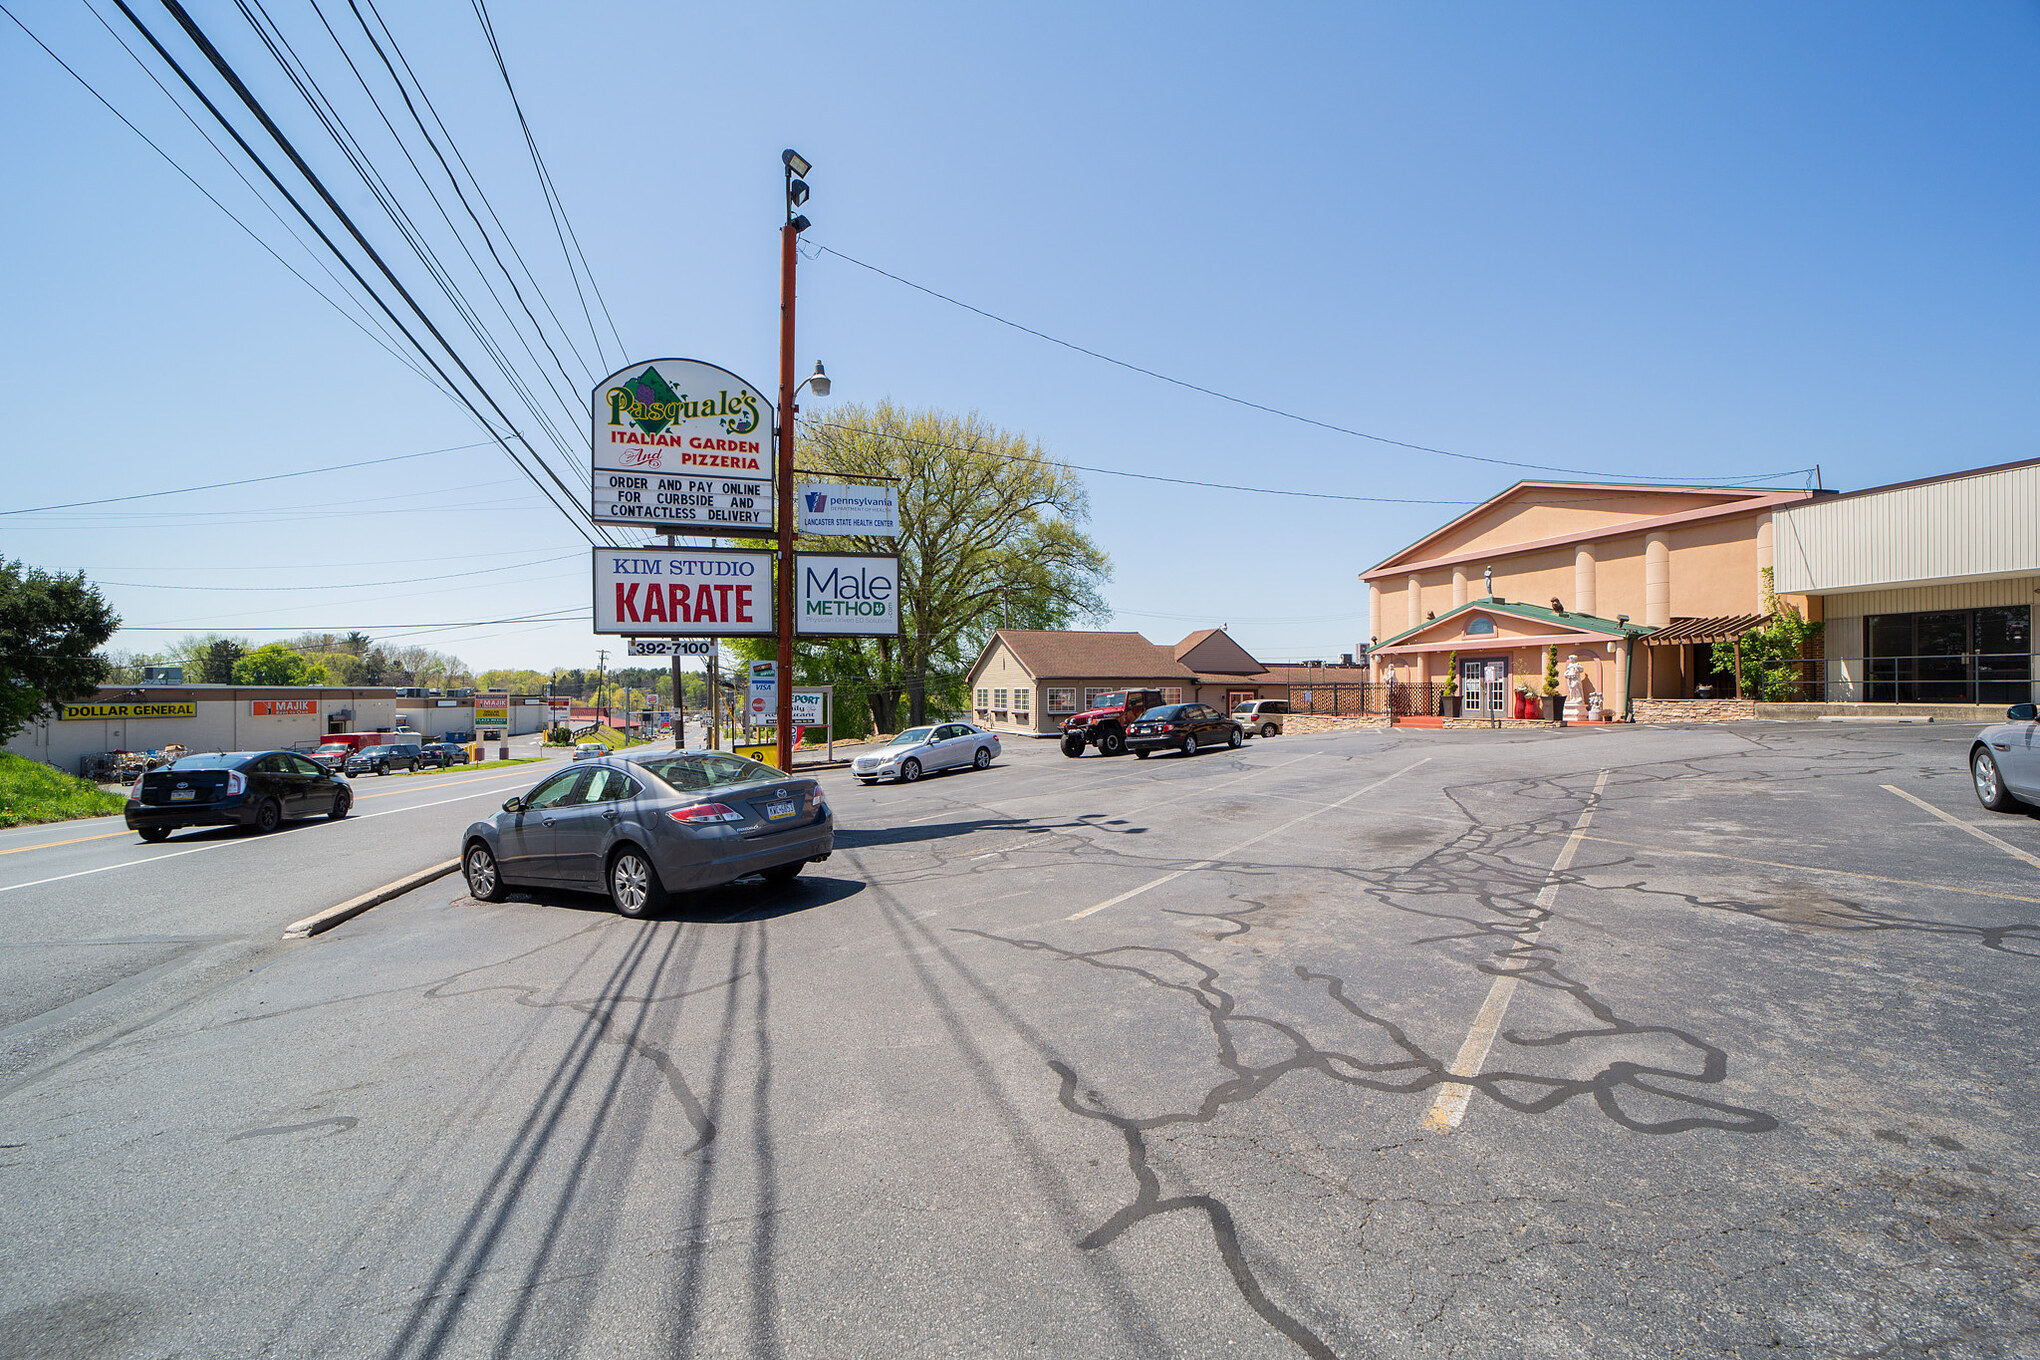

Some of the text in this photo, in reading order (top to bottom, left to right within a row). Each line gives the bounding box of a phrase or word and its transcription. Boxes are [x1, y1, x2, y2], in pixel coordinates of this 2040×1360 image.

[606, 386, 760, 436] Pasquale's
[610, 430, 760, 454] ITALIAN GARDEN
[618, 447, 760, 470] And PIZZERIA
[609, 476, 761, 496] ORDER AND PAY ONLINE
[618, 490, 754, 509] FOR CURBSIDE AND
[830, 497, 893, 507] pennsylvania
[611, 504, 760, 522] CONTACTLESS DELIVERY
[804, 518, 835, 526] LANCASTER
[853, 519, 873, 527] HEALTH
[612, 558, 755, 577] KIM STUDIO
[806, 567, 892, 600] Male
[615, 582, 753, 623] KARATE
[806, 600, 886, 616] METHOD
[636, 642, 710, 654] 392-7100
[68, 705, 193, 717] DOLLAR GENERAL
[275, 700, 309, 711] MAJIK
